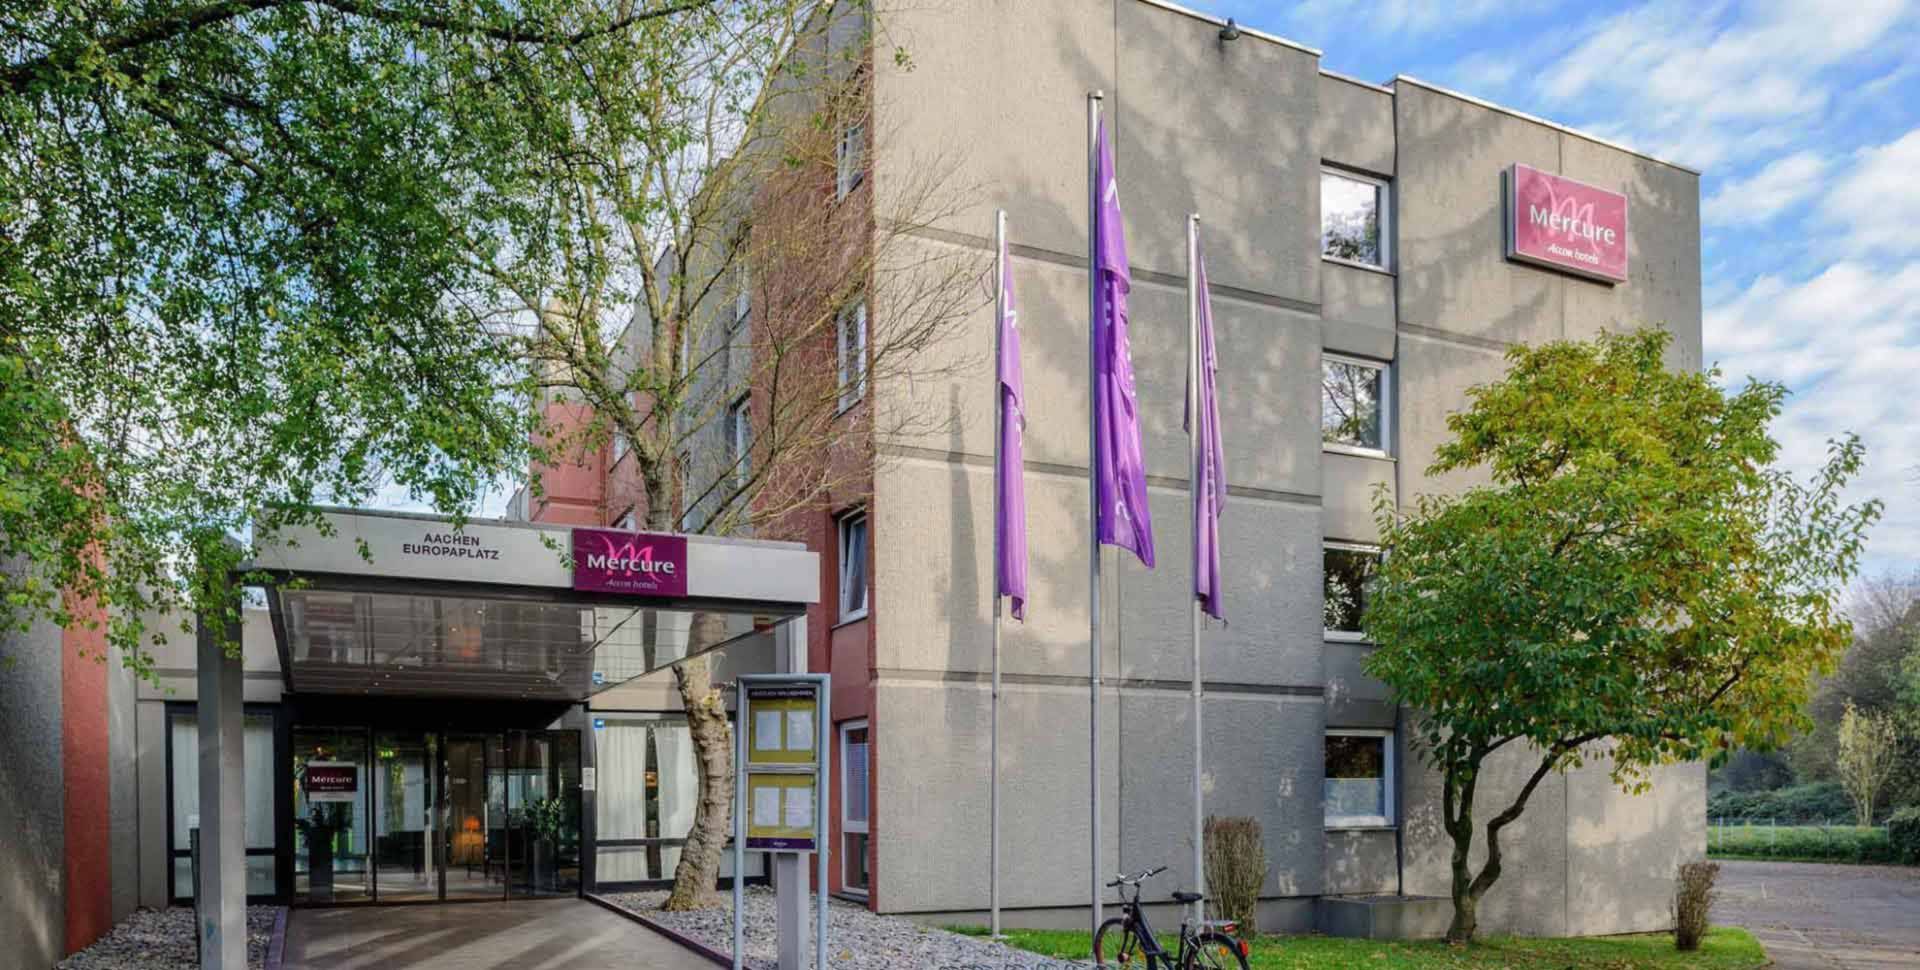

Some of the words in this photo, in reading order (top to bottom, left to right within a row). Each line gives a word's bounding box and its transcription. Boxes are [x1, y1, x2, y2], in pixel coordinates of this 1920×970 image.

[1529, 204, 1616, 245] Mercure
[424, 533, 480, 546] AACHEN
[403, 543, 500, 560] EUROPAPLATZ
[587, 553, 675, 574] Mercure
[311, 775, 352, 784] Mercure
